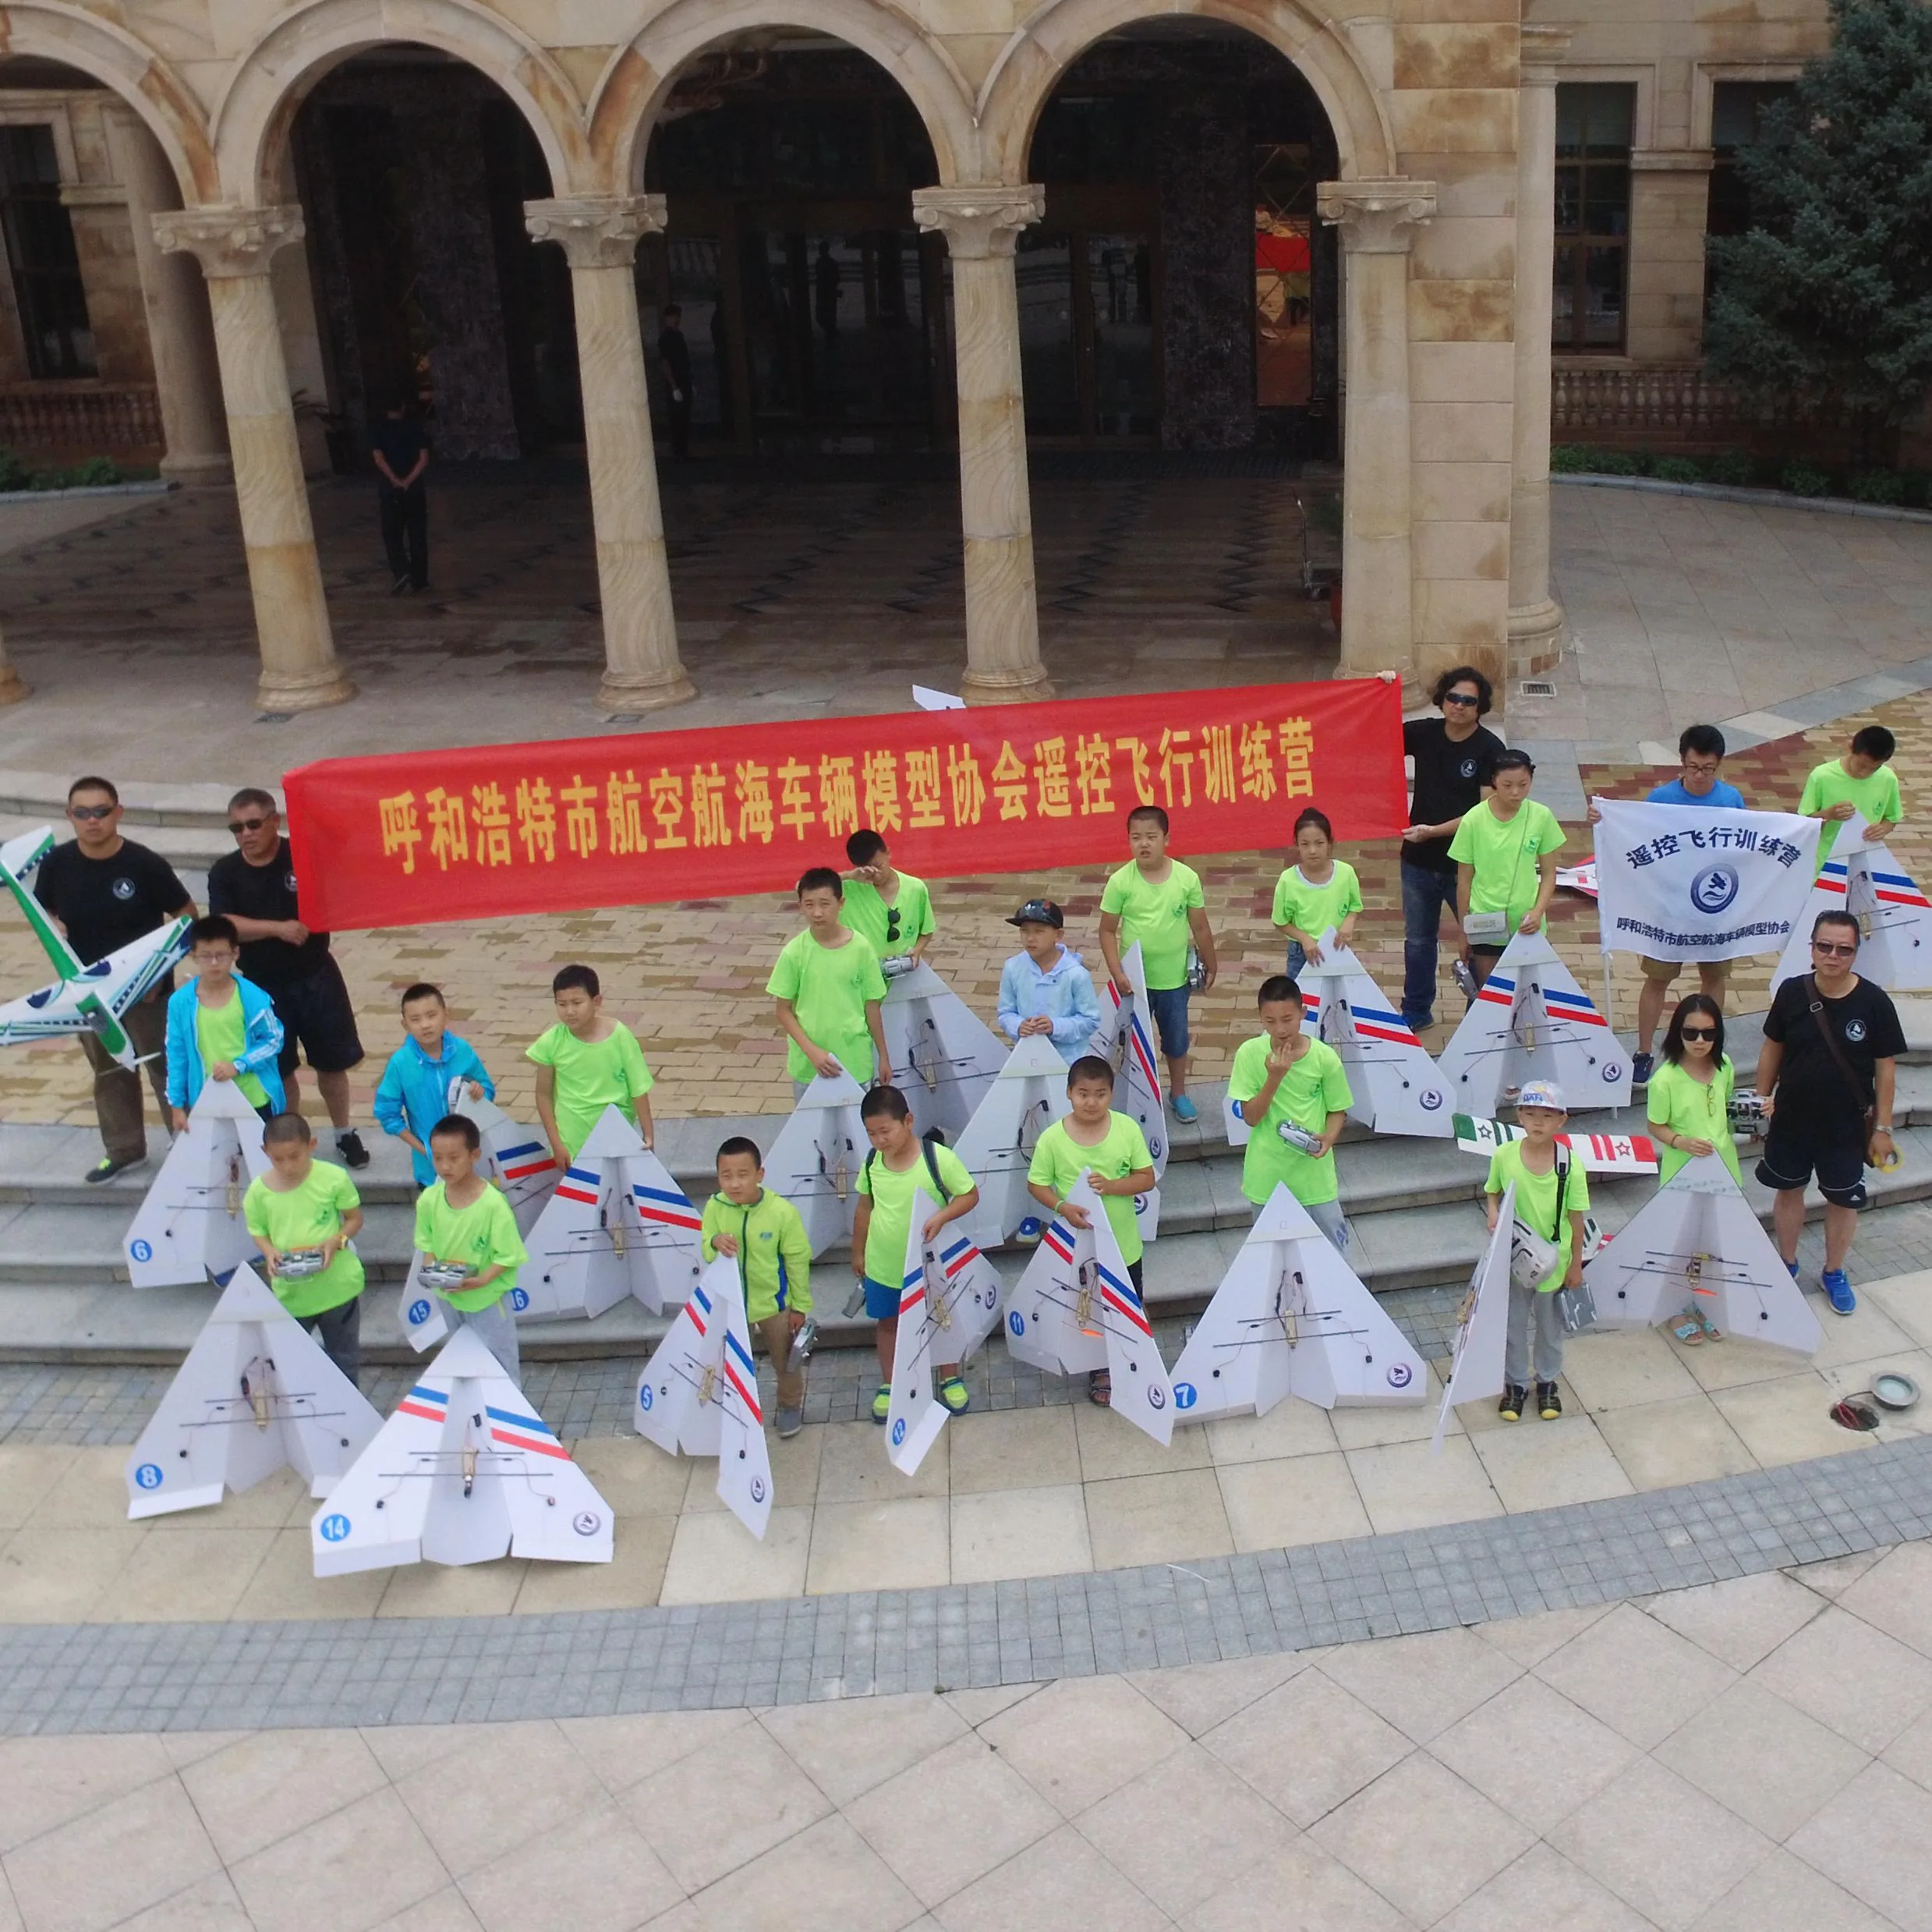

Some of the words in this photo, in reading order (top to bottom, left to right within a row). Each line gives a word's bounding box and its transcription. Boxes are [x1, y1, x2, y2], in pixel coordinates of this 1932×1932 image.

[379, 716, 1315, 874] 呼和浩特市航空航海车辆模型协会遥控飞行训练营
[1626, 826, 1802, 869] 遥控飞行训练营
[135, 1241, 148, 1260] 6
[412, 1302, 426, 1322] 15
[642, 1387, 650, 1408] 5
[1176, 1385, 1189, 1407] 7
[142, 1466, 157, 1487] 8
[325, 1517, 345, 1538] 14
